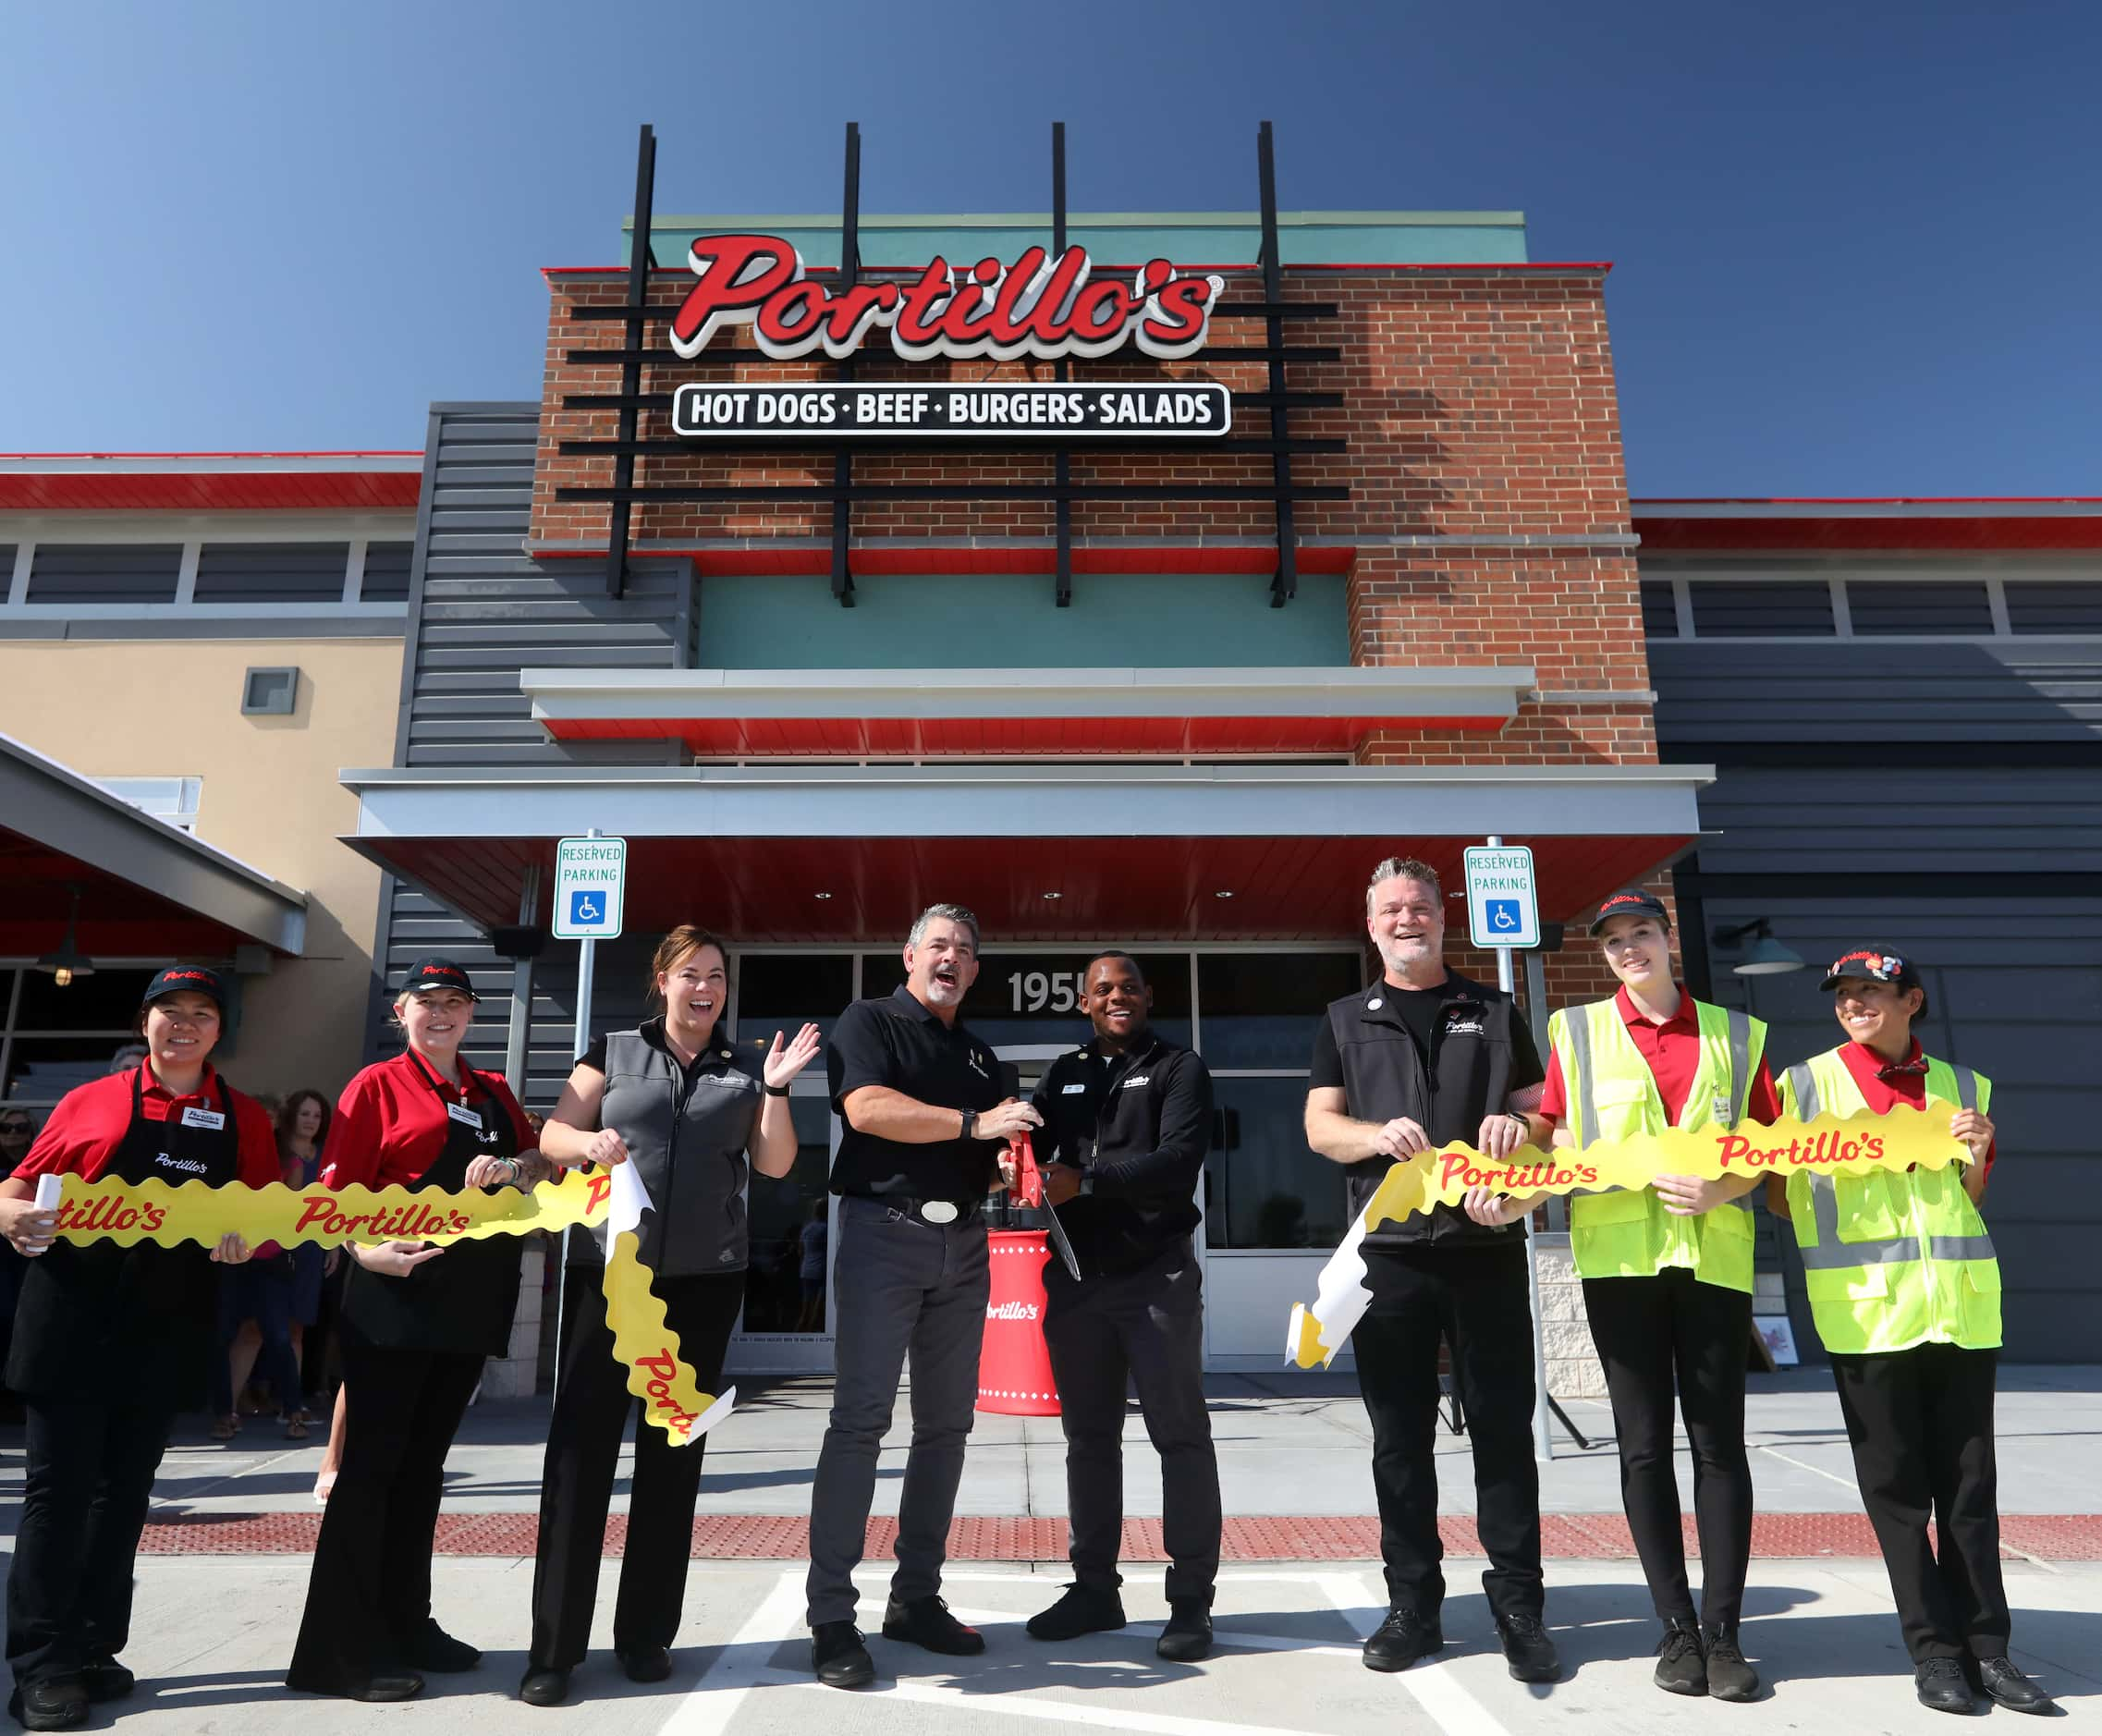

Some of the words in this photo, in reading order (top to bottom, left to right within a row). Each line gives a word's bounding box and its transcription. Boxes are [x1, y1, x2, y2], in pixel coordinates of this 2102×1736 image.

[670, 235, 1214, 359] Portillo's
[691, 394, 750, 423] HOT
[757, 394, 837, 423] DOGS
[856, 393, 928, 422] BEEF
[949, 393, 1084, 423] BURGERS
[1099, 393, 1212, 423] SALADS
[562, 848, 621, 861] RESERVED
[1470, 857, 1528, 869] RESERVED
[564, 869, 617, 881] PARKING
[1474, 877, 1527, 889] PARKING
[1717, 1131, 1885, 1168] Portillo's
[154, 1152, 208, 1174] Portillo's
[1439, 1153, 1598, 1192] Portillo's
[295, 1196, 471, 1236] Portillo's
[986, 1302, 1037, 1320] ortillo's
